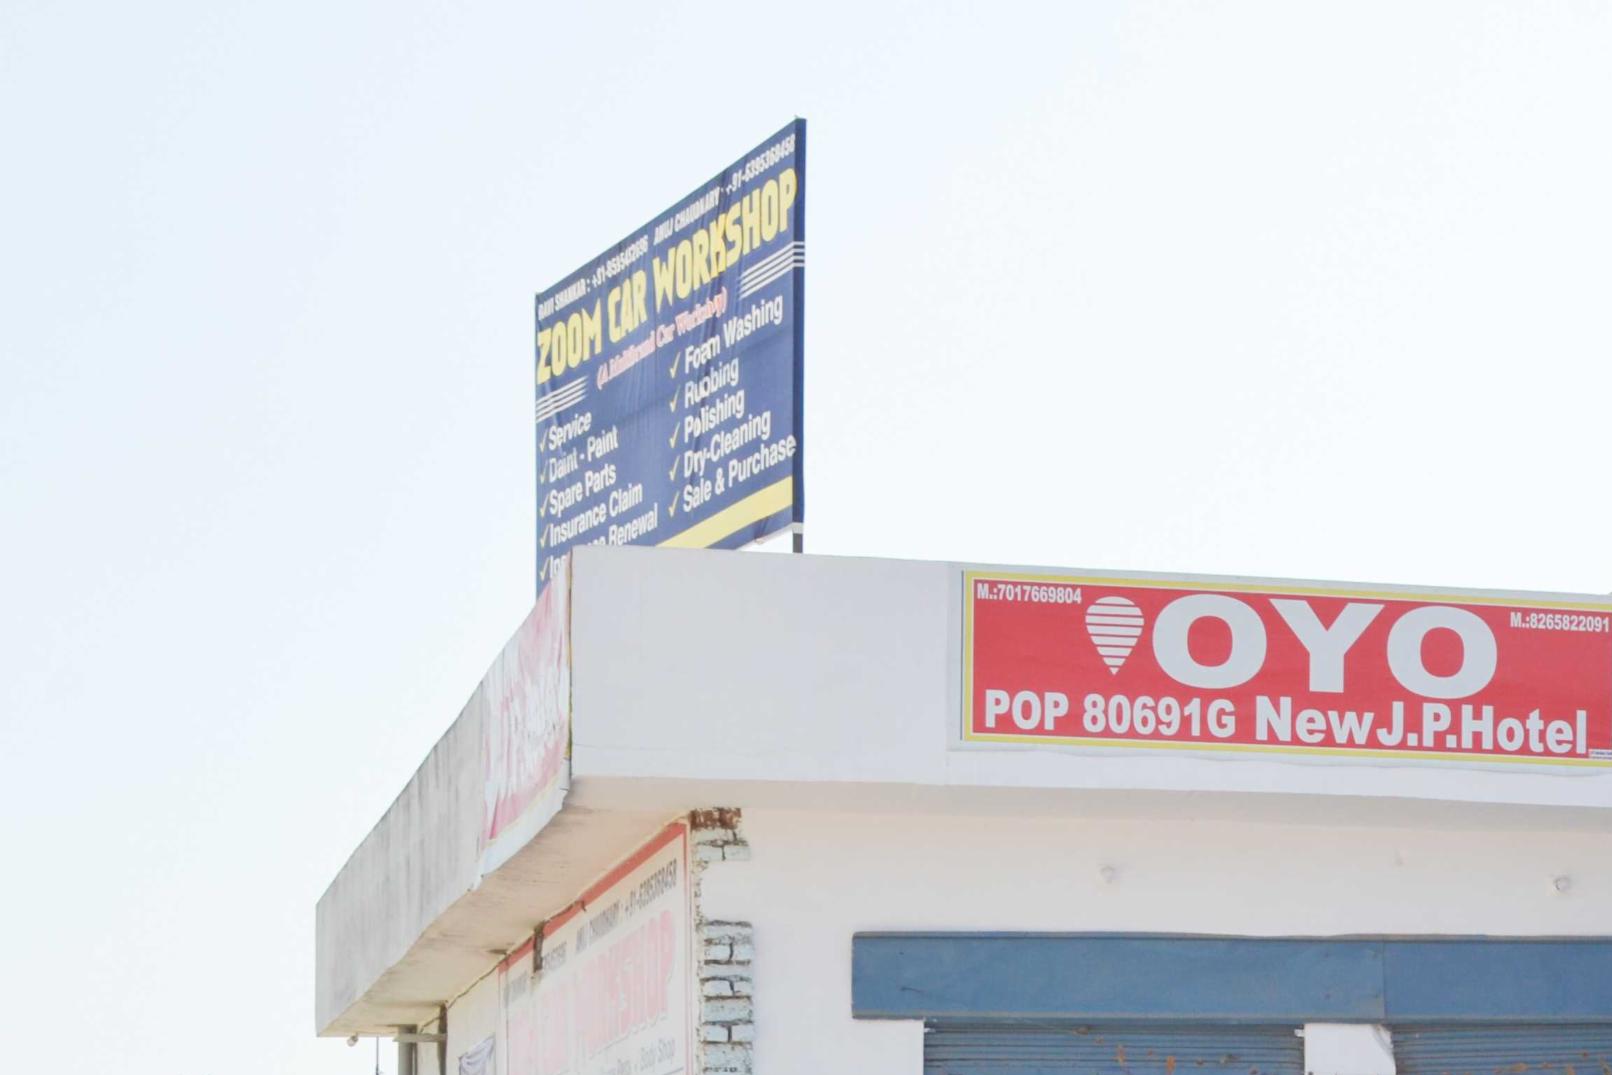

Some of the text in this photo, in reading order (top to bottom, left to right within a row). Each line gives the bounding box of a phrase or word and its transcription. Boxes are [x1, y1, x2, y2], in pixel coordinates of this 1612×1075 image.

[537, 298, 602, 385] ZOOM
[607, 270, 648, 343] CAR
[653, 167, 797, 313] WORKSHOP
[685, 295, 783, 374] Foam Washing
[684, 358, 739, 408] Rubbing
[549, 412, 592, 451] Service
[587, 425, 619, 462] Paint
[684, 390, 745, 443] Polishing
[684, 411, 771, 478] Dry-Cleaning
[550, 463, 617, 518] Spare Parts
[683, 434, 797, 513] Sale & Purchase
[550, 483, 643, 547] Insurance Claim
[608, 502, 658, 546] Renewal
[1152, 593, 1498, 700] OYO
[984, 688, 1070, 730] POP
[1082, 692, 1236, 739] 80691G
